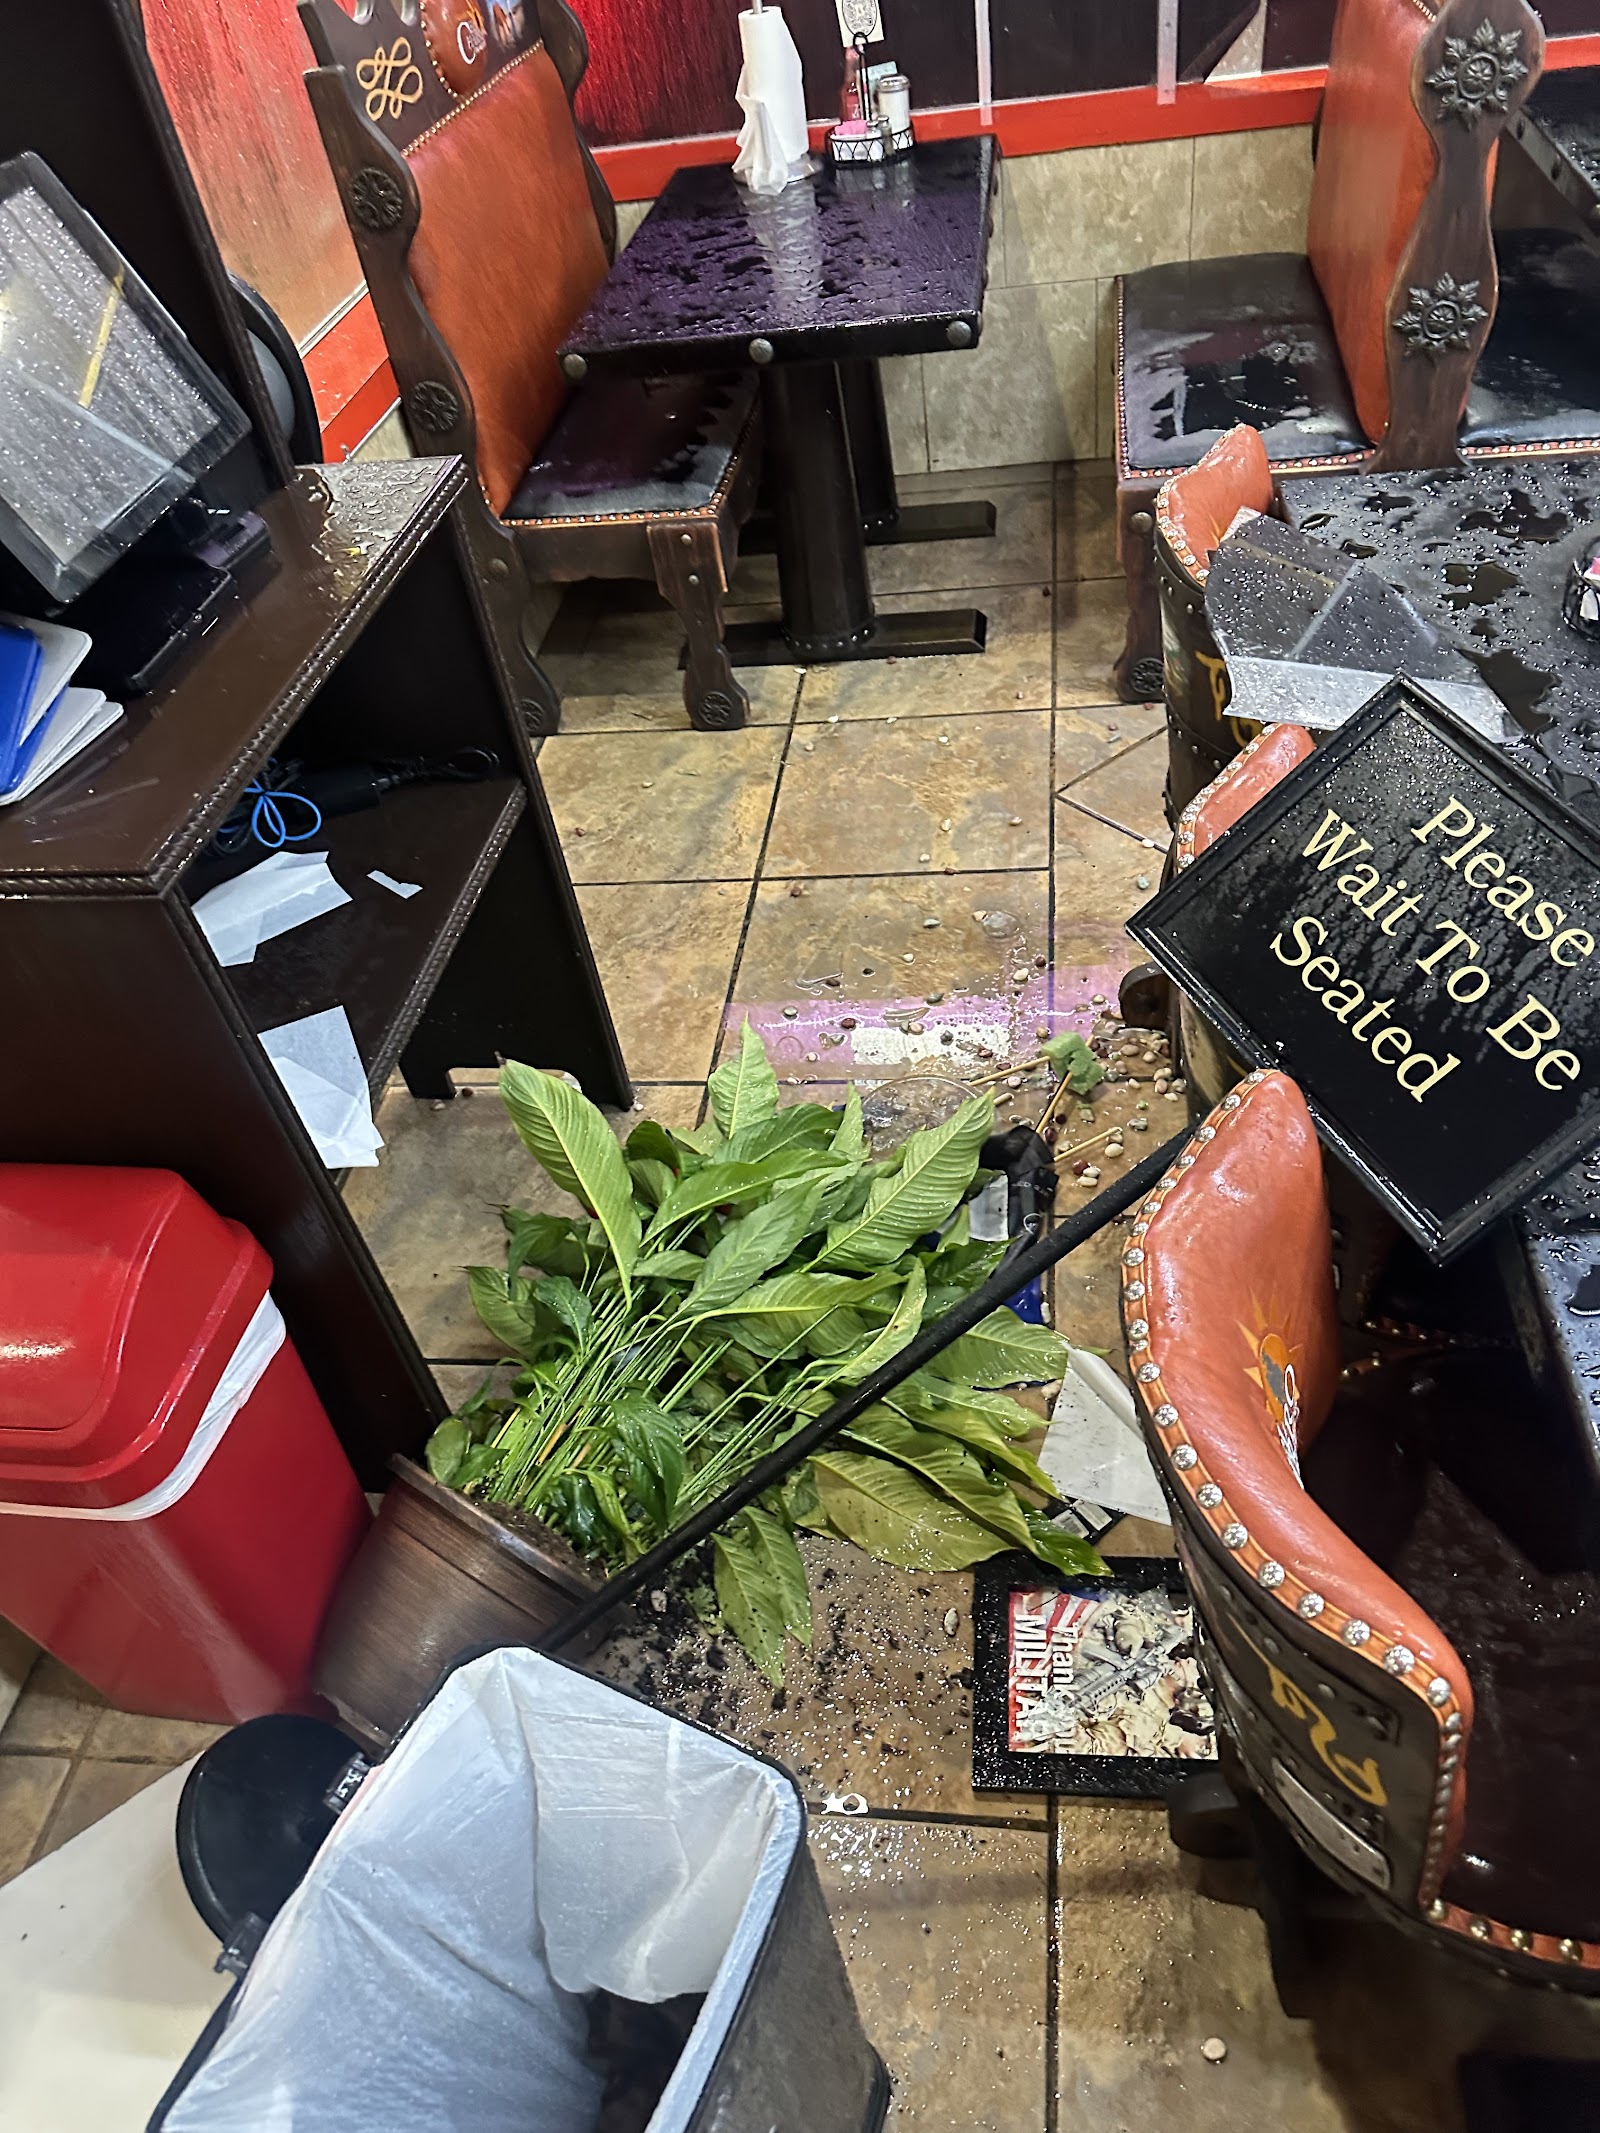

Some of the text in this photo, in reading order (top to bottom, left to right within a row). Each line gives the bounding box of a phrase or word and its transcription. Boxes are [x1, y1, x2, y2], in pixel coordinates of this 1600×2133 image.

[1301, 808, 1582, 1091] Wait To Be
[1410, 796, 1595, 967] Please
[1269, 915, 1461, 1103] Seated
[1051, 1621, 1080, 1699] Thank
